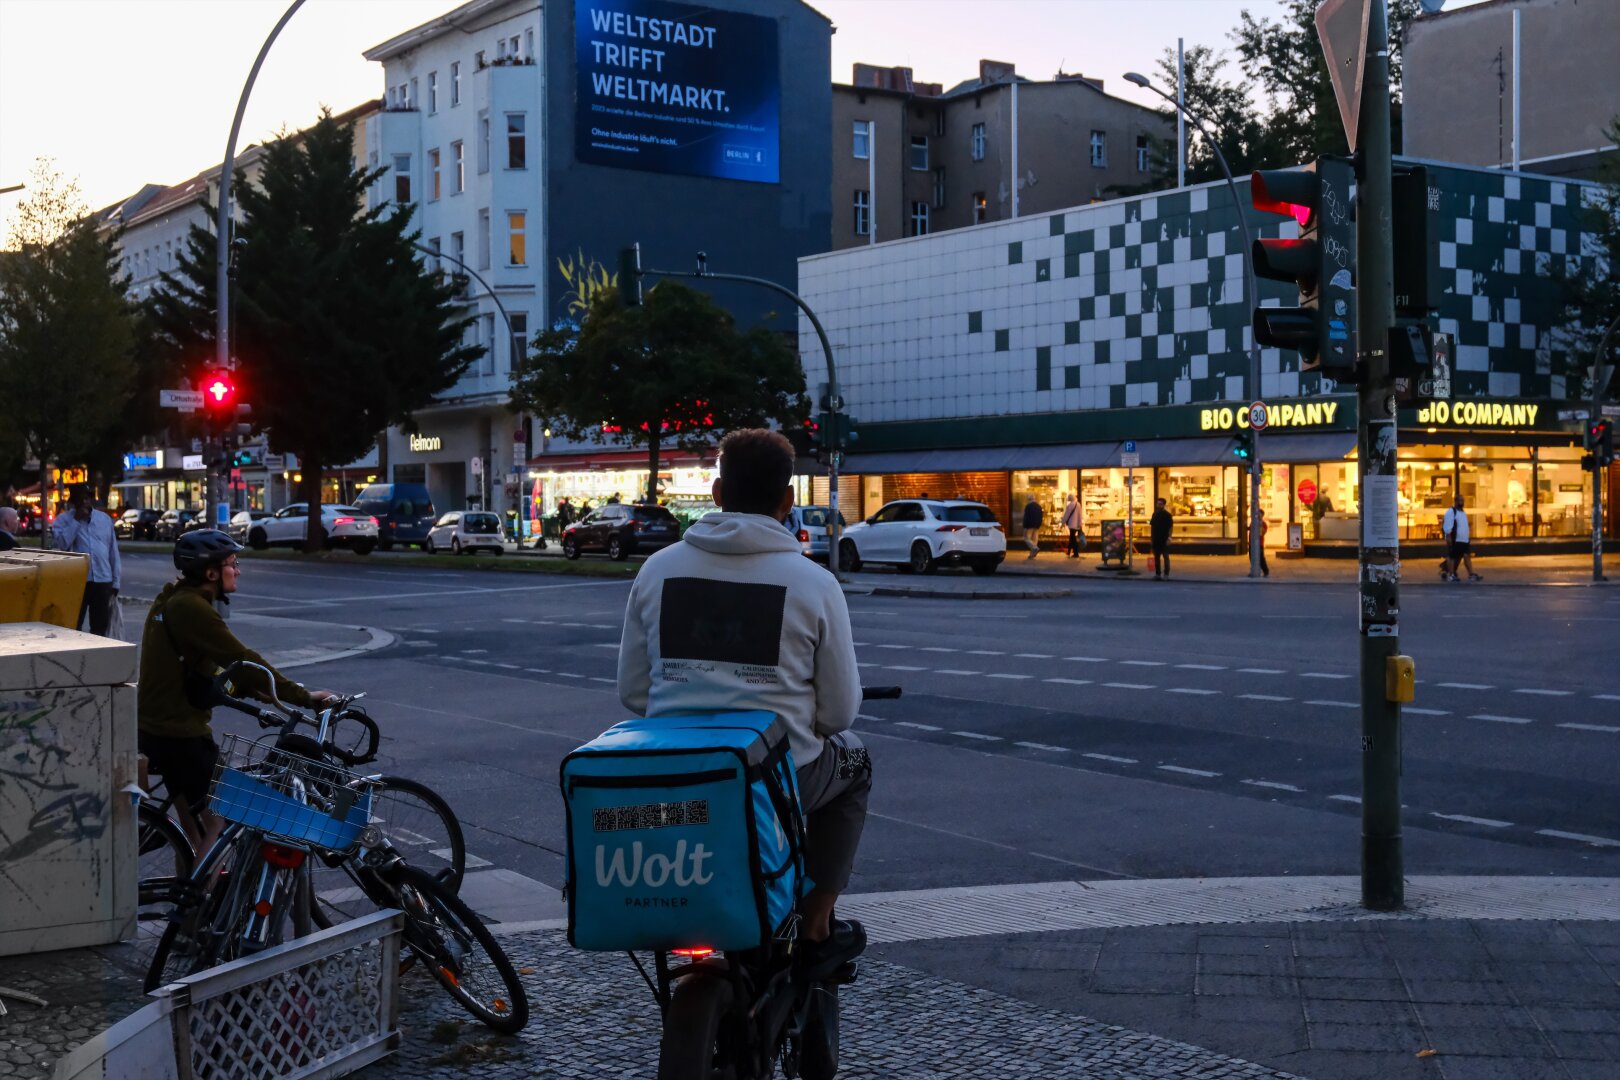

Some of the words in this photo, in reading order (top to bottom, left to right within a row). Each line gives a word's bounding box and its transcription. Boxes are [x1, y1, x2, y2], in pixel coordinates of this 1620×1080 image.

[591, 8, 716, 49] WELTSTADT
[591, 41, 665, 72] TRIFFT
[592, 72, 730, 113] WELTMARKT.
[592, 127, 609, 137] Ohne
[610, 130, 639, 140] Industrie
[726, 149, 750, 159] BERLIN
[1200, 407, 1233, 431] BIO
[1236, 401, 1337, 429] CMPANY
[1252, 409, 1265, 422] 30
[1418, 400, 1450, 424] BIO
[1452, 401, 1538, 426] COMPANY
[1126, 441, 1133, 451] P
[742, 665, 776, 673] CALIFORNIA
[594, 839, 714, 888] Wolt
[625, 897, 688, 908] PARTNER
